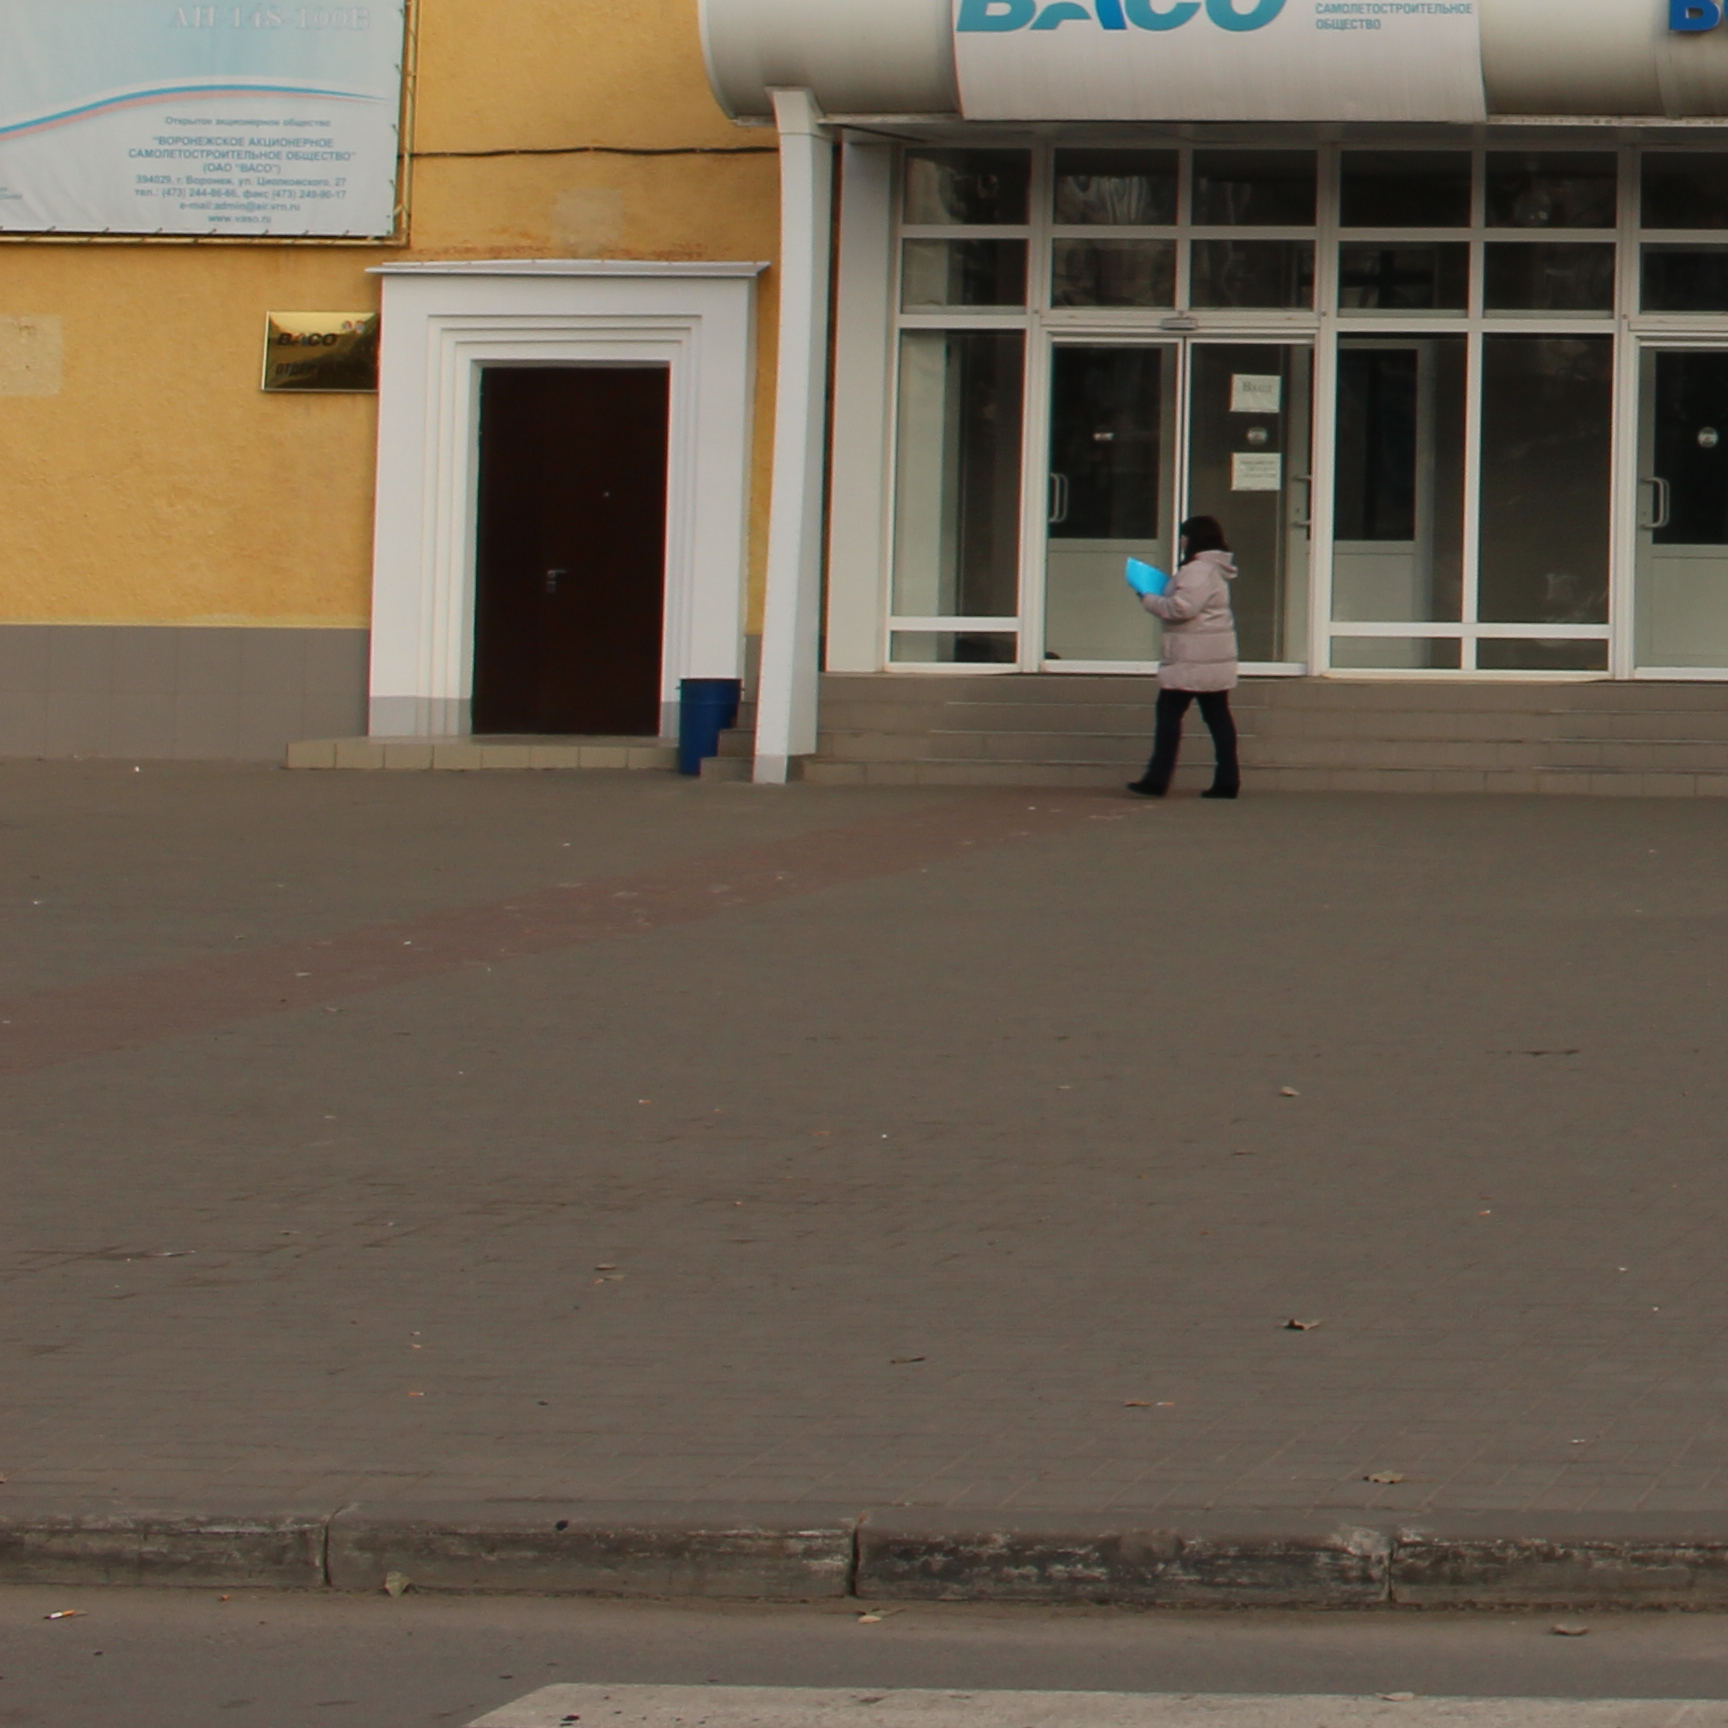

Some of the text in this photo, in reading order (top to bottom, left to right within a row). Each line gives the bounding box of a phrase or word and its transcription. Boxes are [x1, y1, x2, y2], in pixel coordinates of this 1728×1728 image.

[1315, 3, 1473, 14] САМОЛЕТОСТРОИТЕЛЬНОЕ
[1315, 19, 1382, 30] ОБЩЕСТВО
[248, 138, 333, 148] АКЦИОНЕРНОЕ
[128, 149, 282, 160] САМОЛЕТОСТРОИТЕЛЬНОЕ
